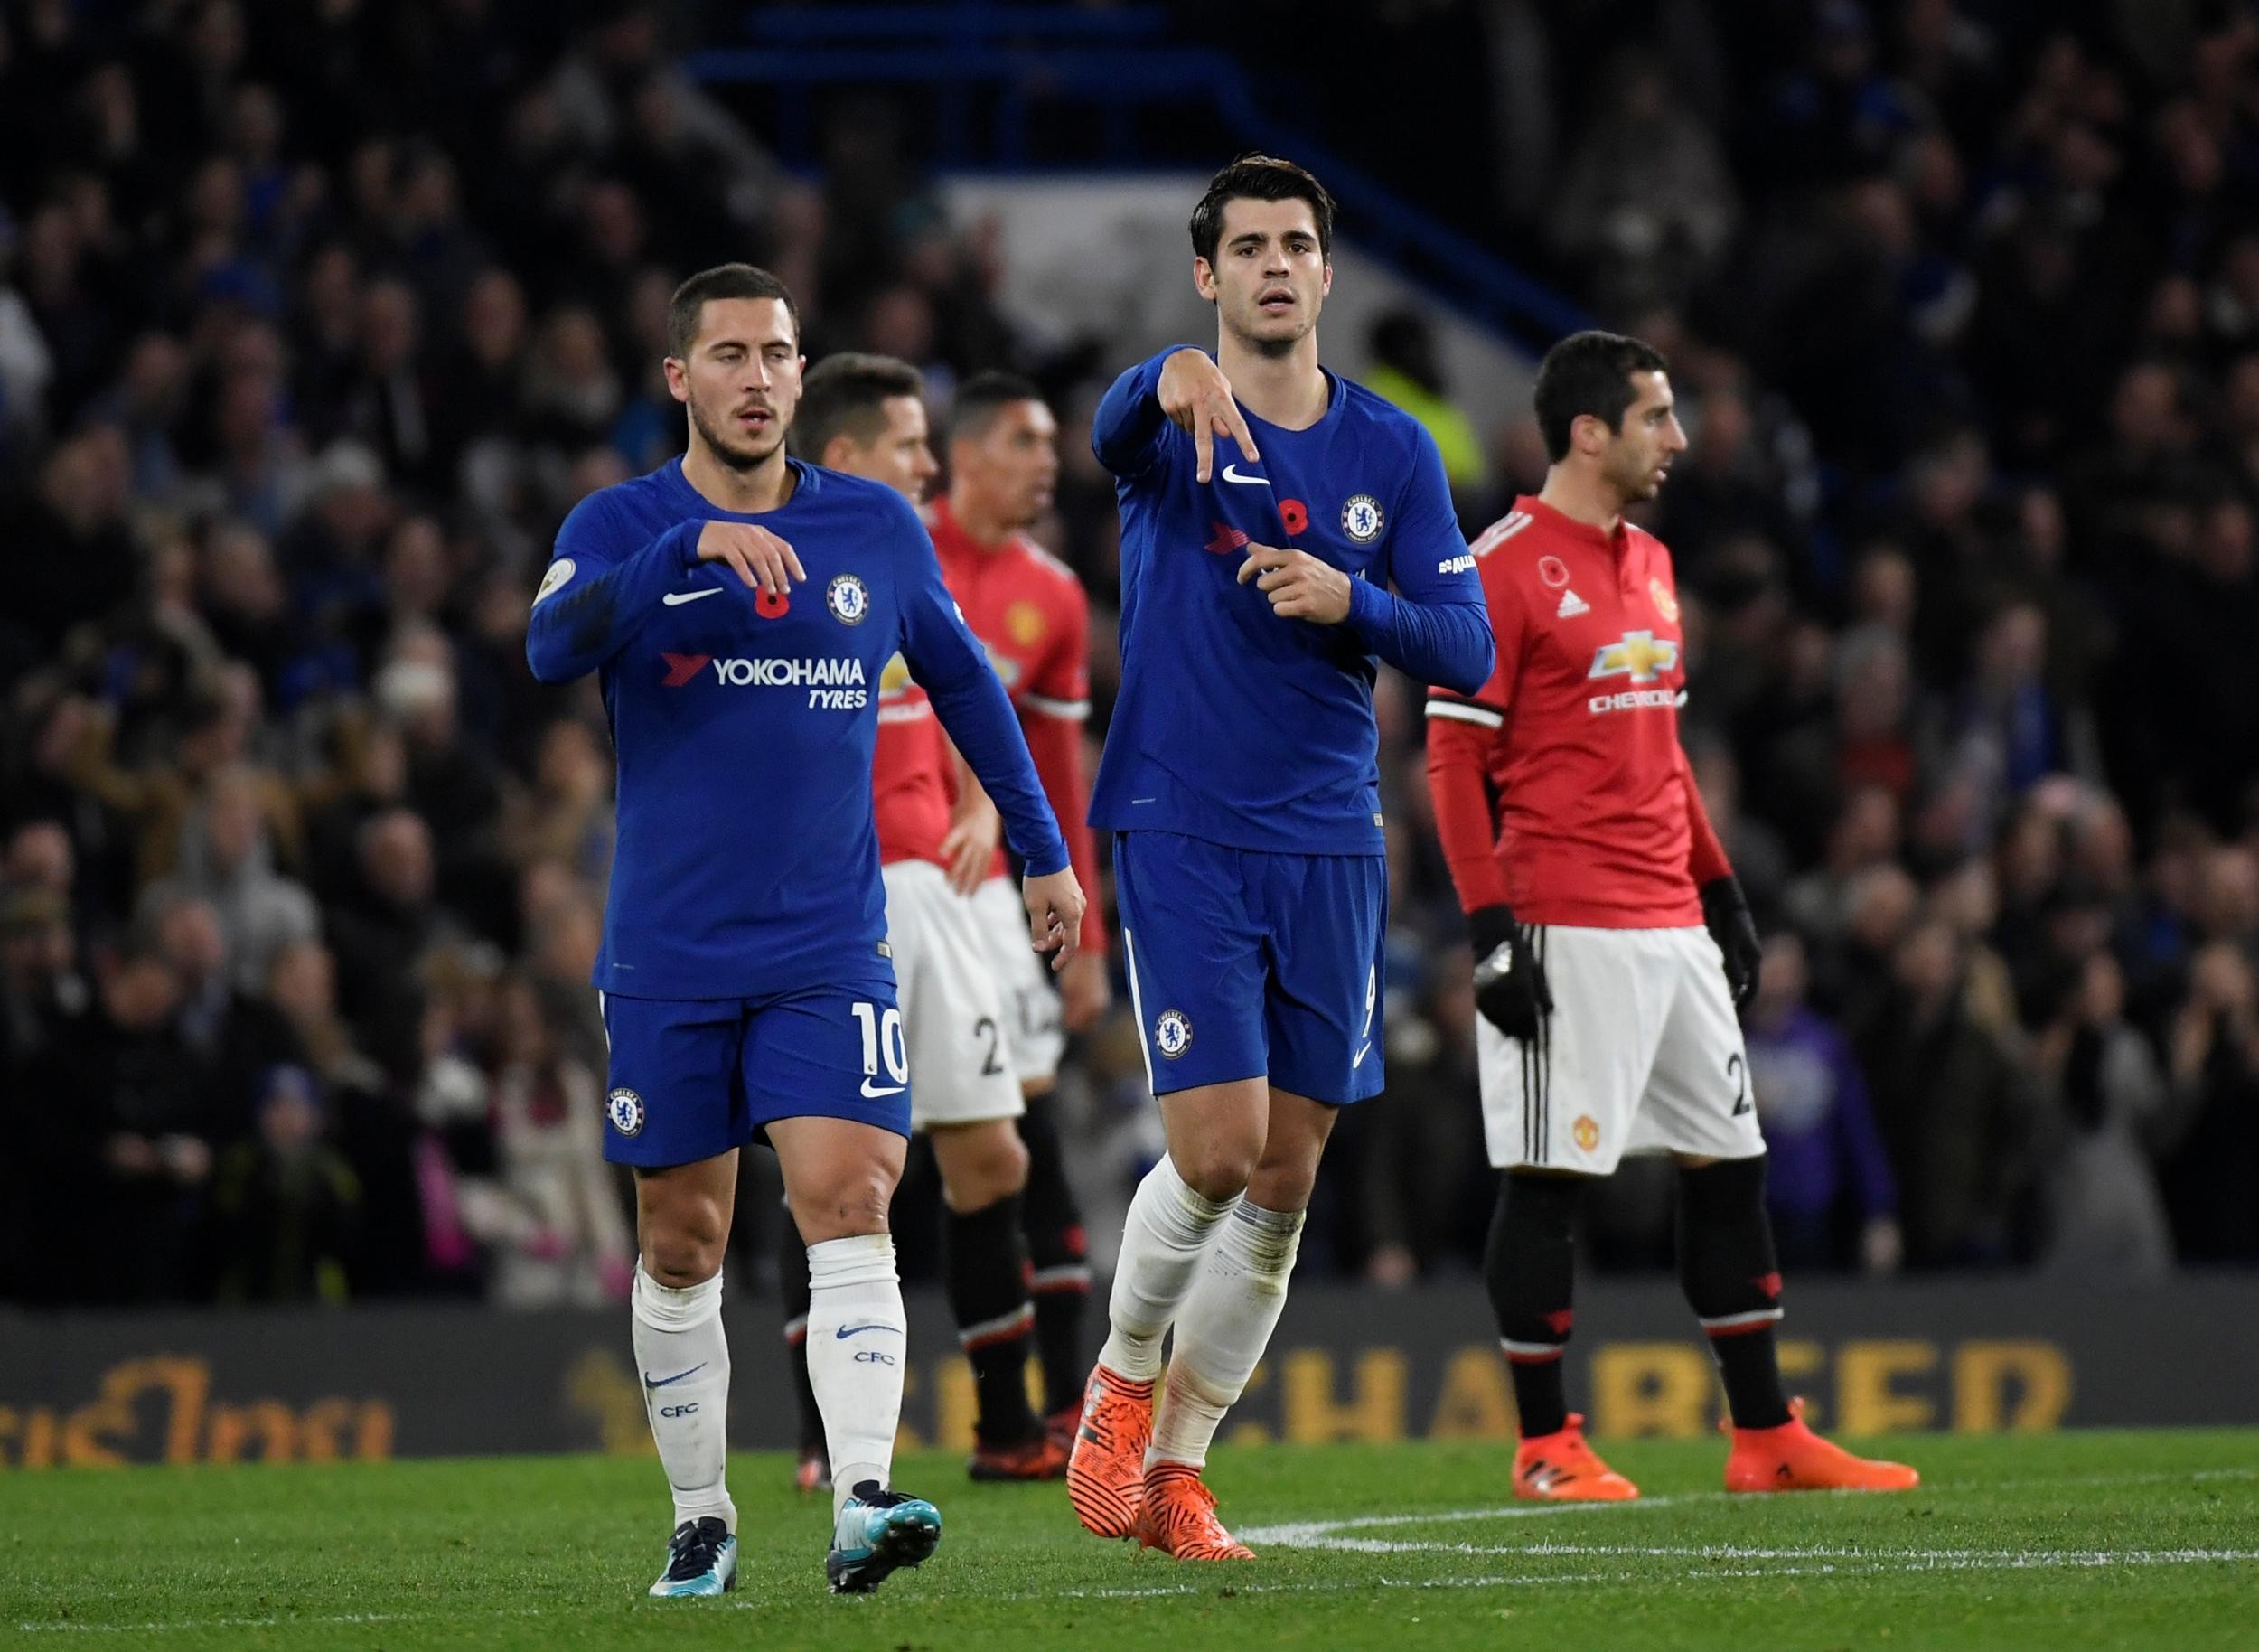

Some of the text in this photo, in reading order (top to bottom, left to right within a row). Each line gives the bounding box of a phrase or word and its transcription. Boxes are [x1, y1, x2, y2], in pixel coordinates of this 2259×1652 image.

[712, 658, 866, 686] YOKOHAMA
[808, 690, 867, 709] TYRES
[1362, 962, 1376, 1038] 9
[851, 1001, 909, 1084] 10
[974, 1016, 1003, 1076] 2
[854, 1351, 895, 1366] CFC
[661, 1403, 698, 1418] CFC
